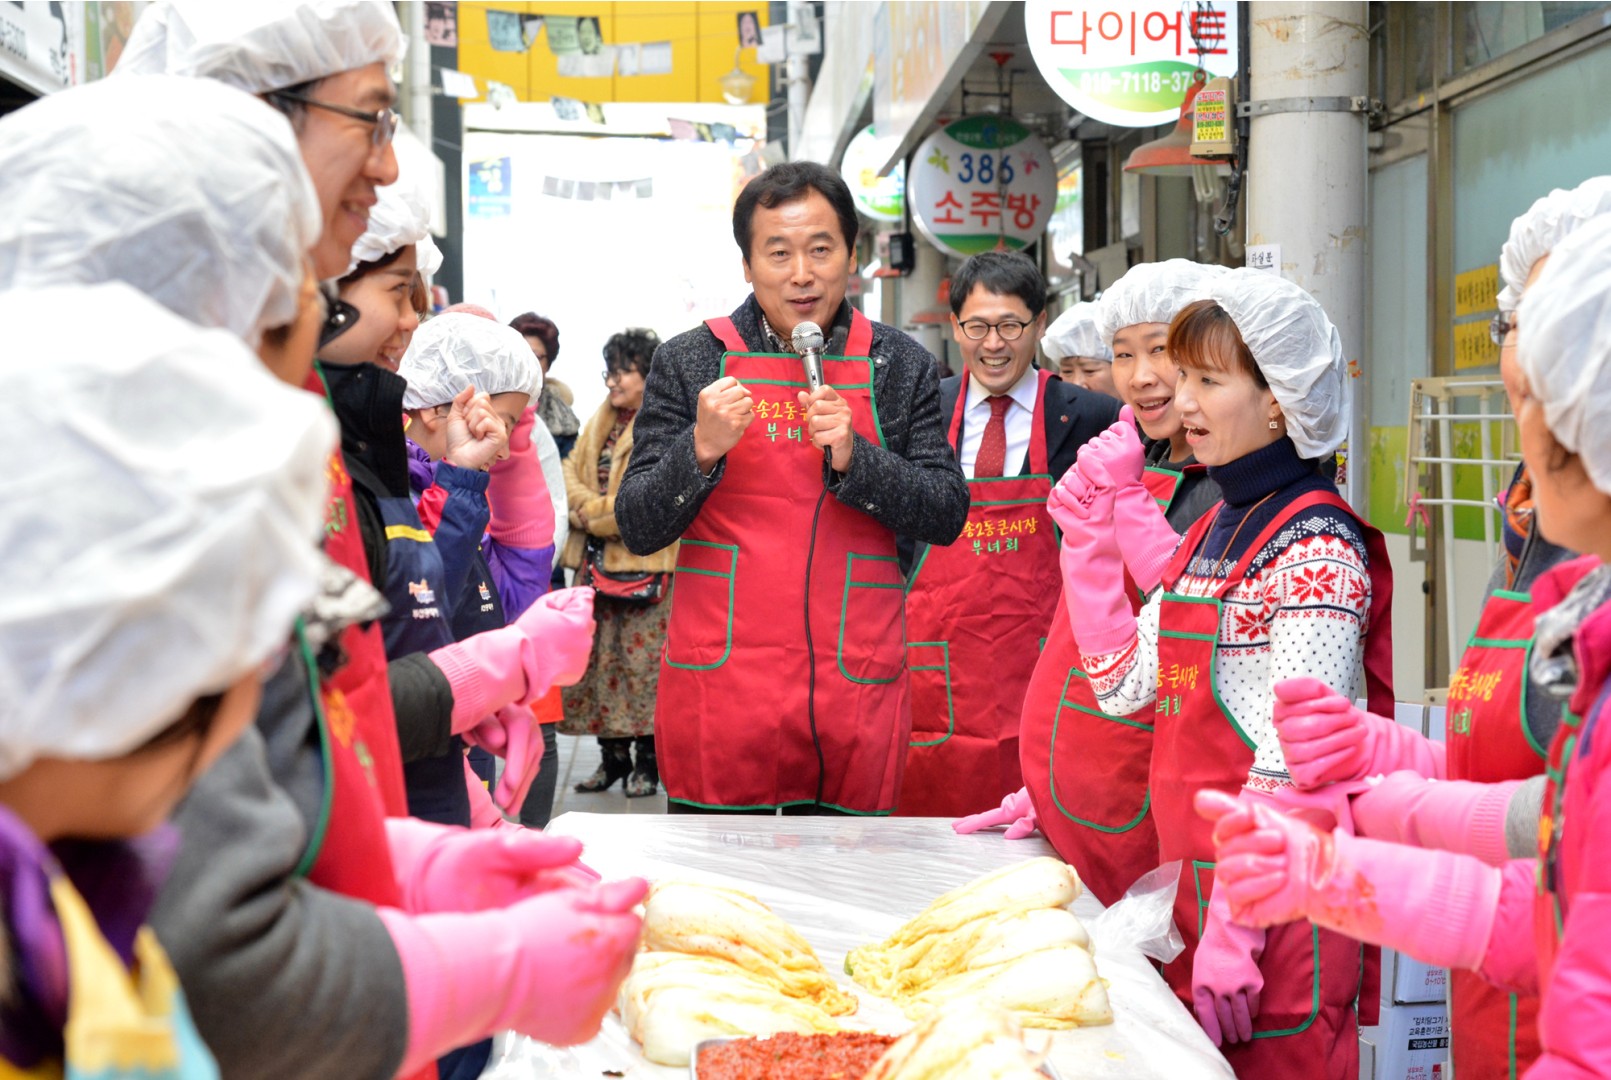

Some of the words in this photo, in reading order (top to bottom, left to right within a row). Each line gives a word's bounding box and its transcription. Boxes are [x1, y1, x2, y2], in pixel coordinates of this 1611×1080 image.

[1050, 11, 1228, 56] 다이어트
[1080, 71, 1210, 94] 010-7118-37
[958, 153, 1015, 185] 386
[933, 191, 1041, 230] 소주방
[752, 399, 808, 422] 송2동
[766, 422, 814, 443] 부녀
[959, 517, 1038, 538] 송2동큰시장
